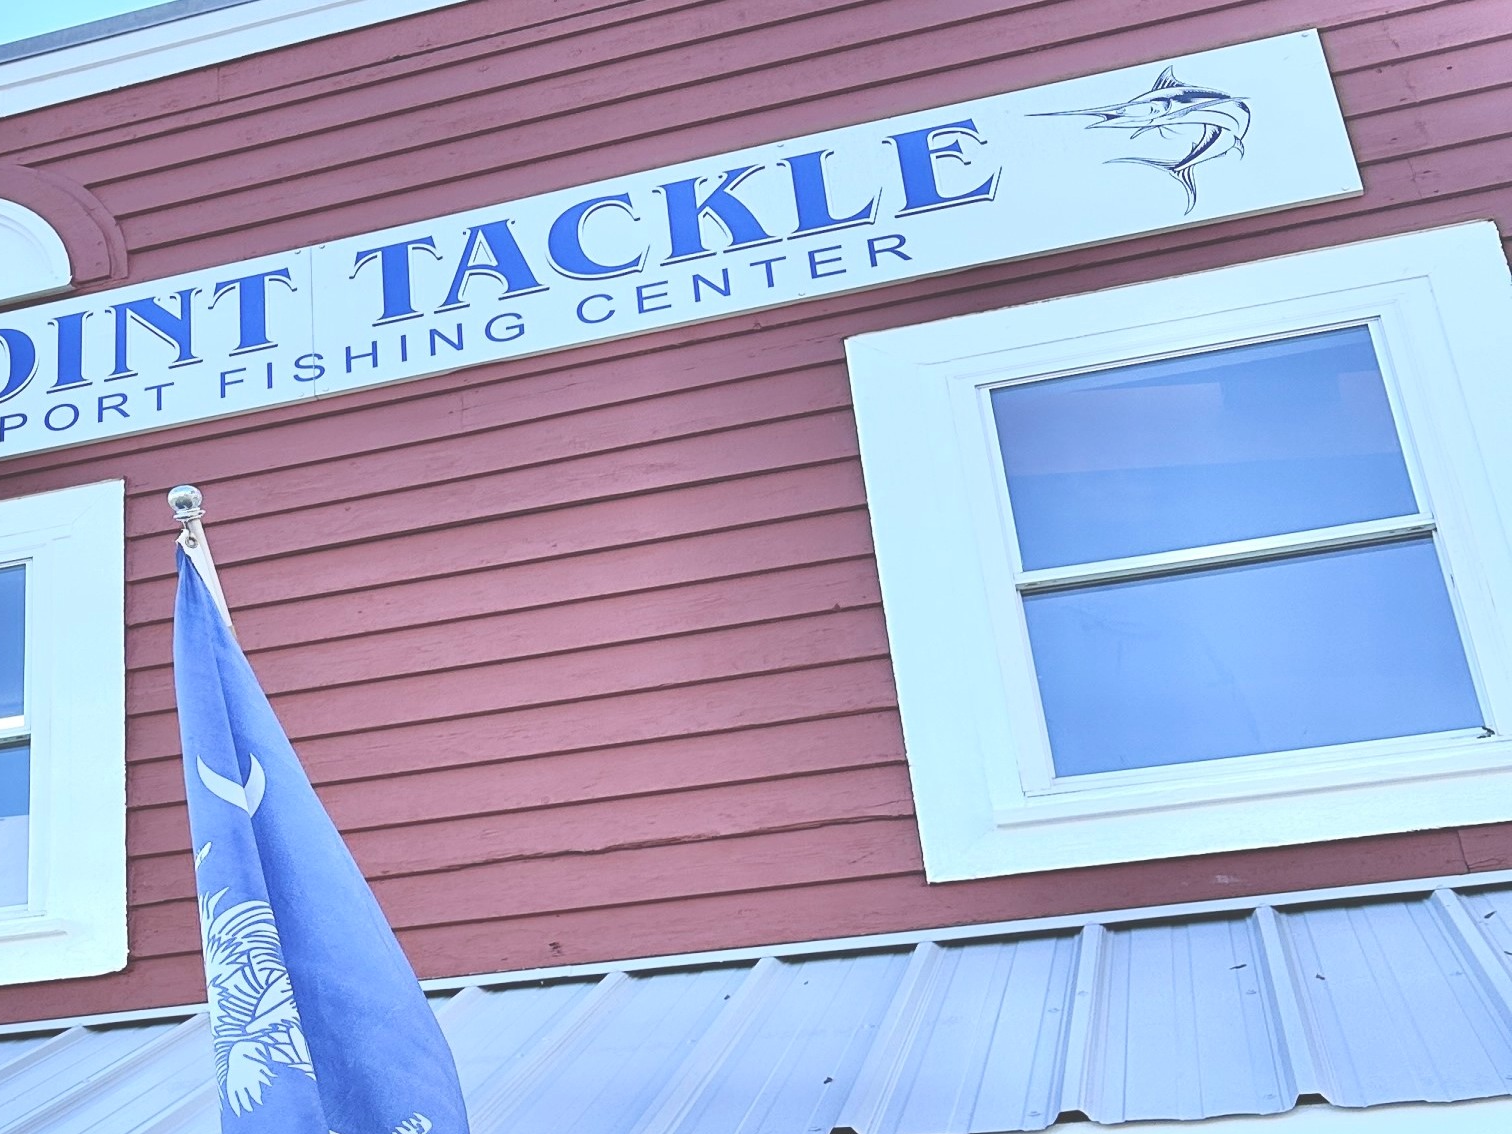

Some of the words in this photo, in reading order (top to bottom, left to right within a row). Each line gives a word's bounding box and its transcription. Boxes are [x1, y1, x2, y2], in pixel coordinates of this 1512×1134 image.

[219, 309, 527, 400] FISHING
[576, 231, 915, 325] CENTER
[348, 117, 1005, 327] TACKLE
